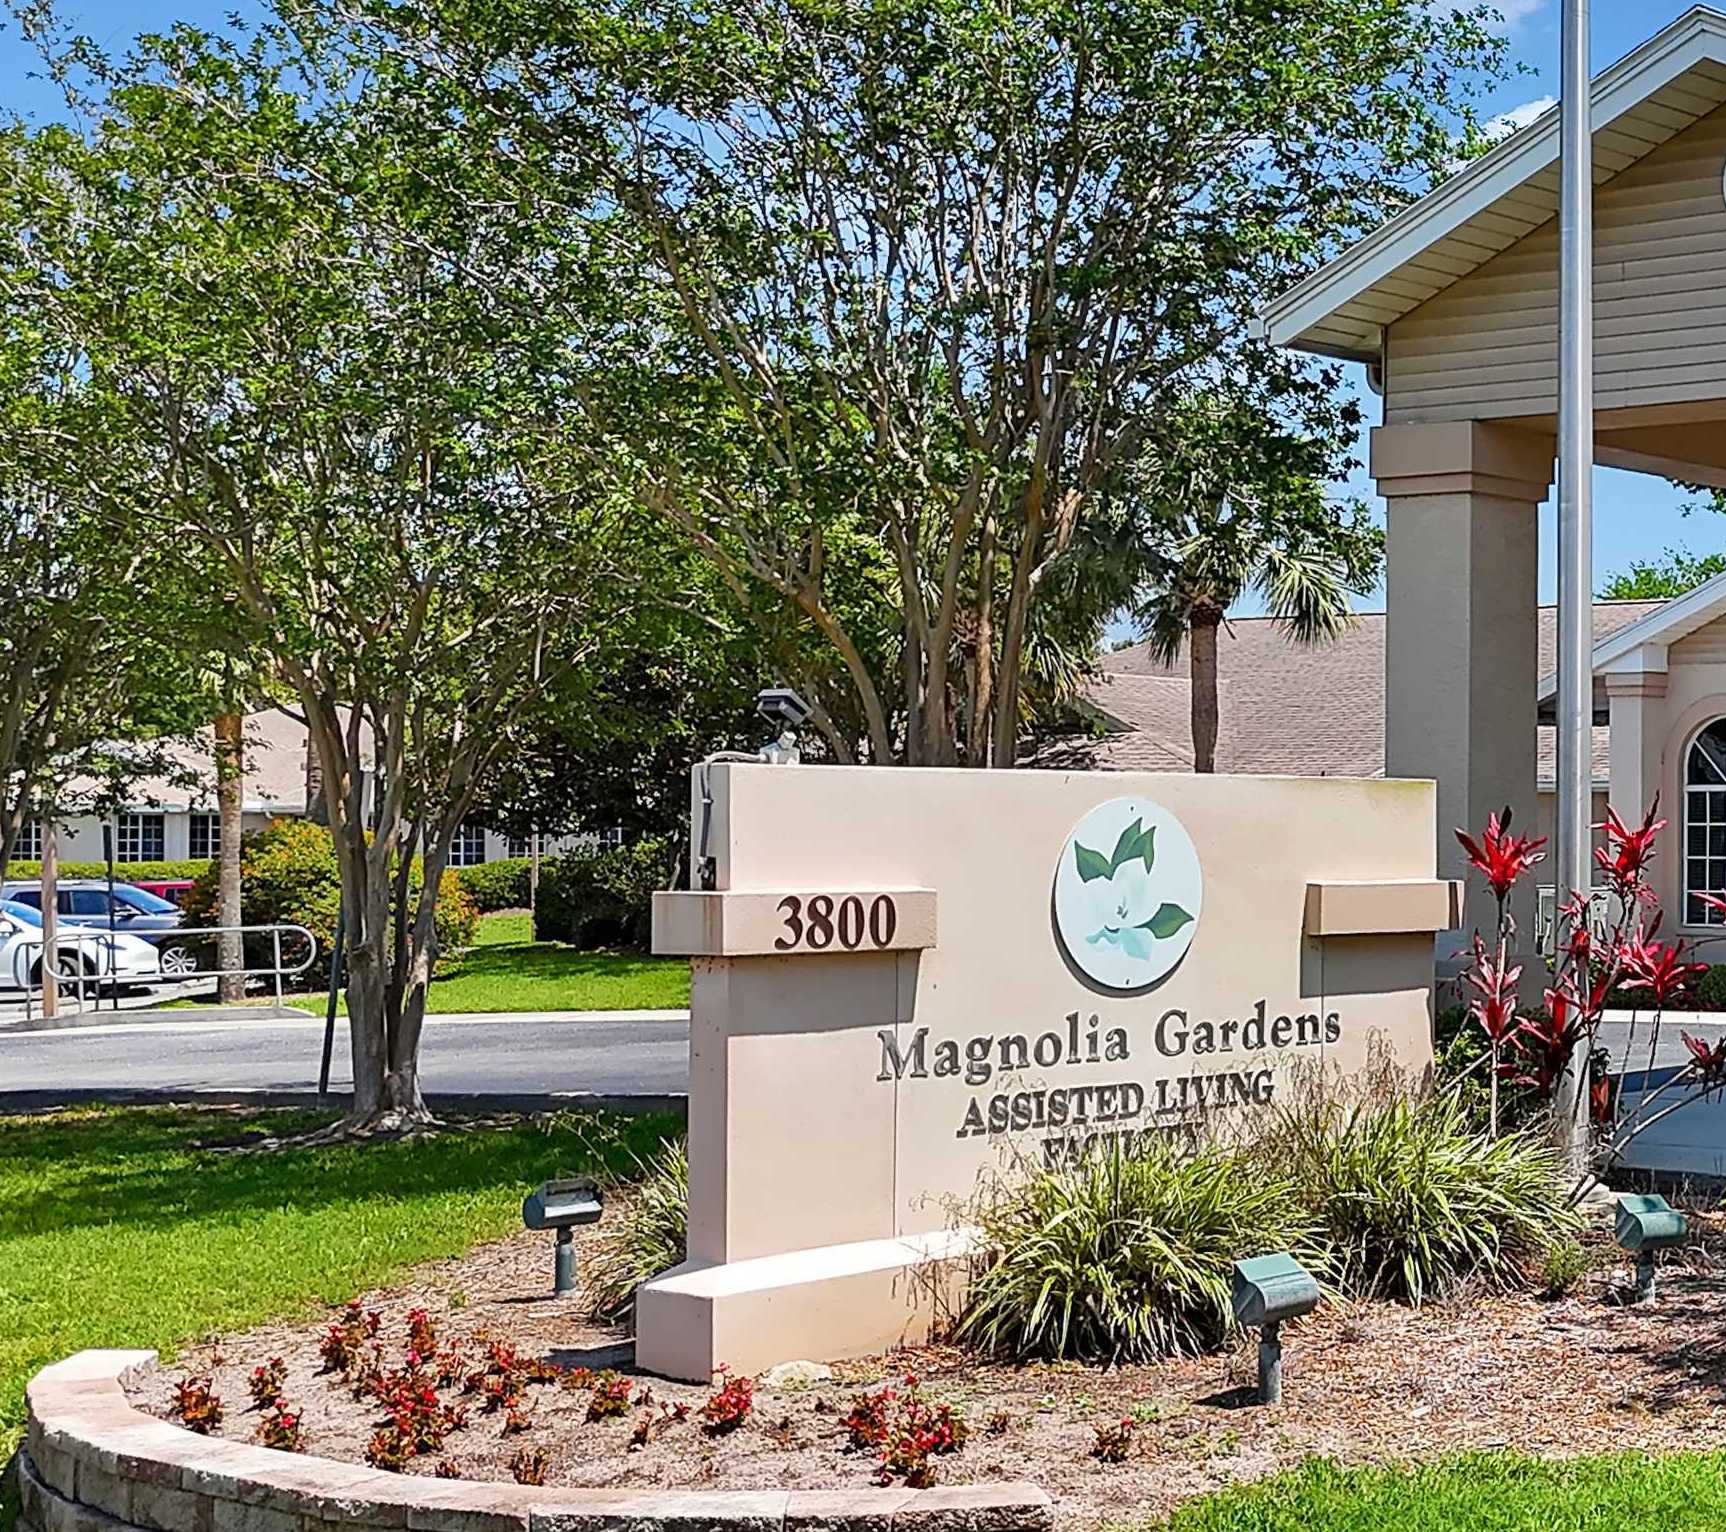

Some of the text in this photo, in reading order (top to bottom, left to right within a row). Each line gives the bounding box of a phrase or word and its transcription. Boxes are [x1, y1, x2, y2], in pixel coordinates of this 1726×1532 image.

[774, 895, 896, 950] 3800
[876, 1000, 1341, 1085] Magnolia Gardens
[956, 1070, 1275, 1138] ASSISTED LIVING
